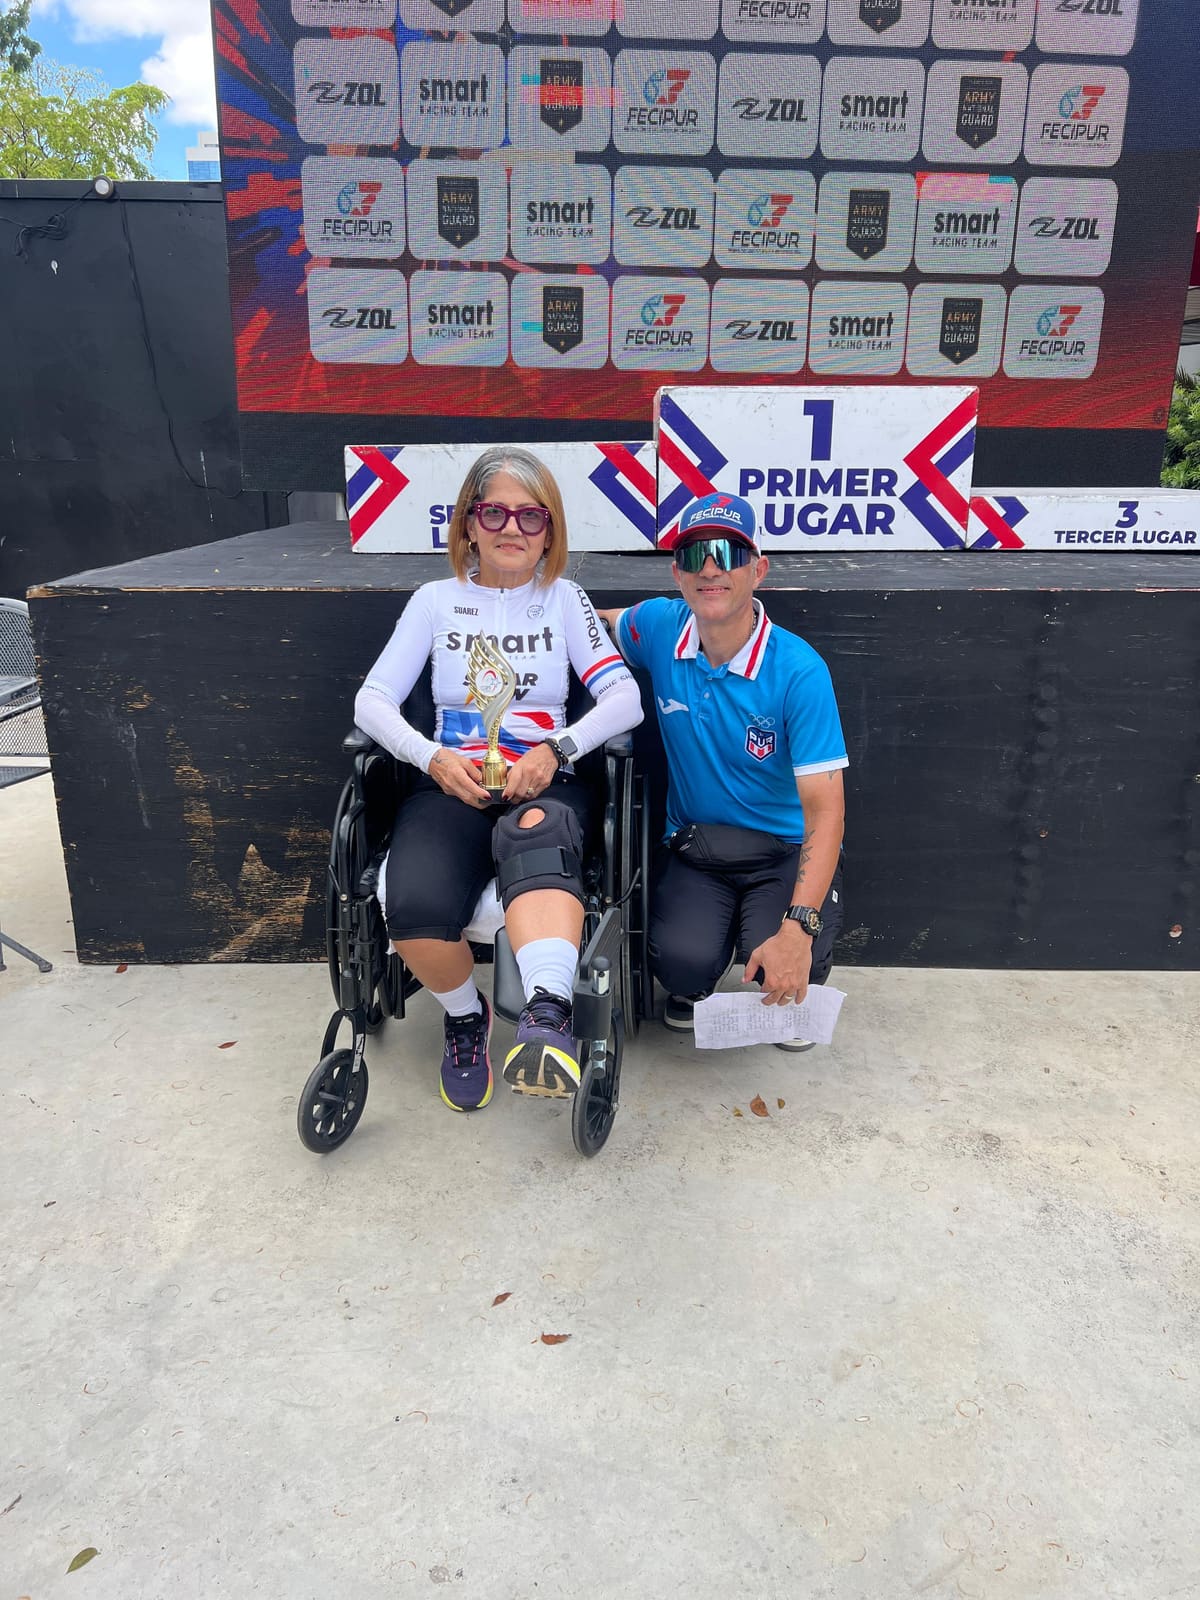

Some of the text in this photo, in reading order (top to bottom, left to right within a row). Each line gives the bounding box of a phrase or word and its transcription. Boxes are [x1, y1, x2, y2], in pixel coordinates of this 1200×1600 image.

[419, 73, 489, 102] smart
[419, 105, 489, 117] RACING TEAM
[840, 91, 909, 119] smart
[627, 107, 699, 126] FECIPUR
[961, 114, 994, 126] GUARD
[839, 121, 907, 132] RACING TEAM
[1040, 123, 1110, 141] FECIPUR
[526, 197, 594, 223] smart
[323, 219, 393, 236] FECIPUR
[442, 215, 476, 225] GUARD
[659, 208, 700, 230] ZOL
[933, 208, 1000, 234] smart
[526, 227, 593, 238] RACING TEAM
[1059, 217, 1100, 240] ZOL
[731, 231, 800, 248] FECIPUR
[932, 237, 998, 248] RACING TEAM
[355, 308, 396, 330] ZOL
[428, 300, 493, 326] smart
[757, 320, 798, 341] ZOL
[828, 312, 894, 337] smart
[428, 328, 494, 339] RACING TEAM
[625, 329, 693, 346] FECIPUR
[944, 333, 976, 343] GUARD
[827, 340, 892, 350] RACING TEAM
[1019, 340, 1086, 356] FECIPUR
[803, 399, 834, 461] 1
[738, 468, 898, 497] PRIMER
[690, 507, 741, 522] FECIPUR
[759, 503, 896, 535] UGAR
[1115, 501, 1138, 528] 3
[1053, 530, 1197, 545] TERCER LUGAR
[453, 606, 479, 616] SUAREZ
